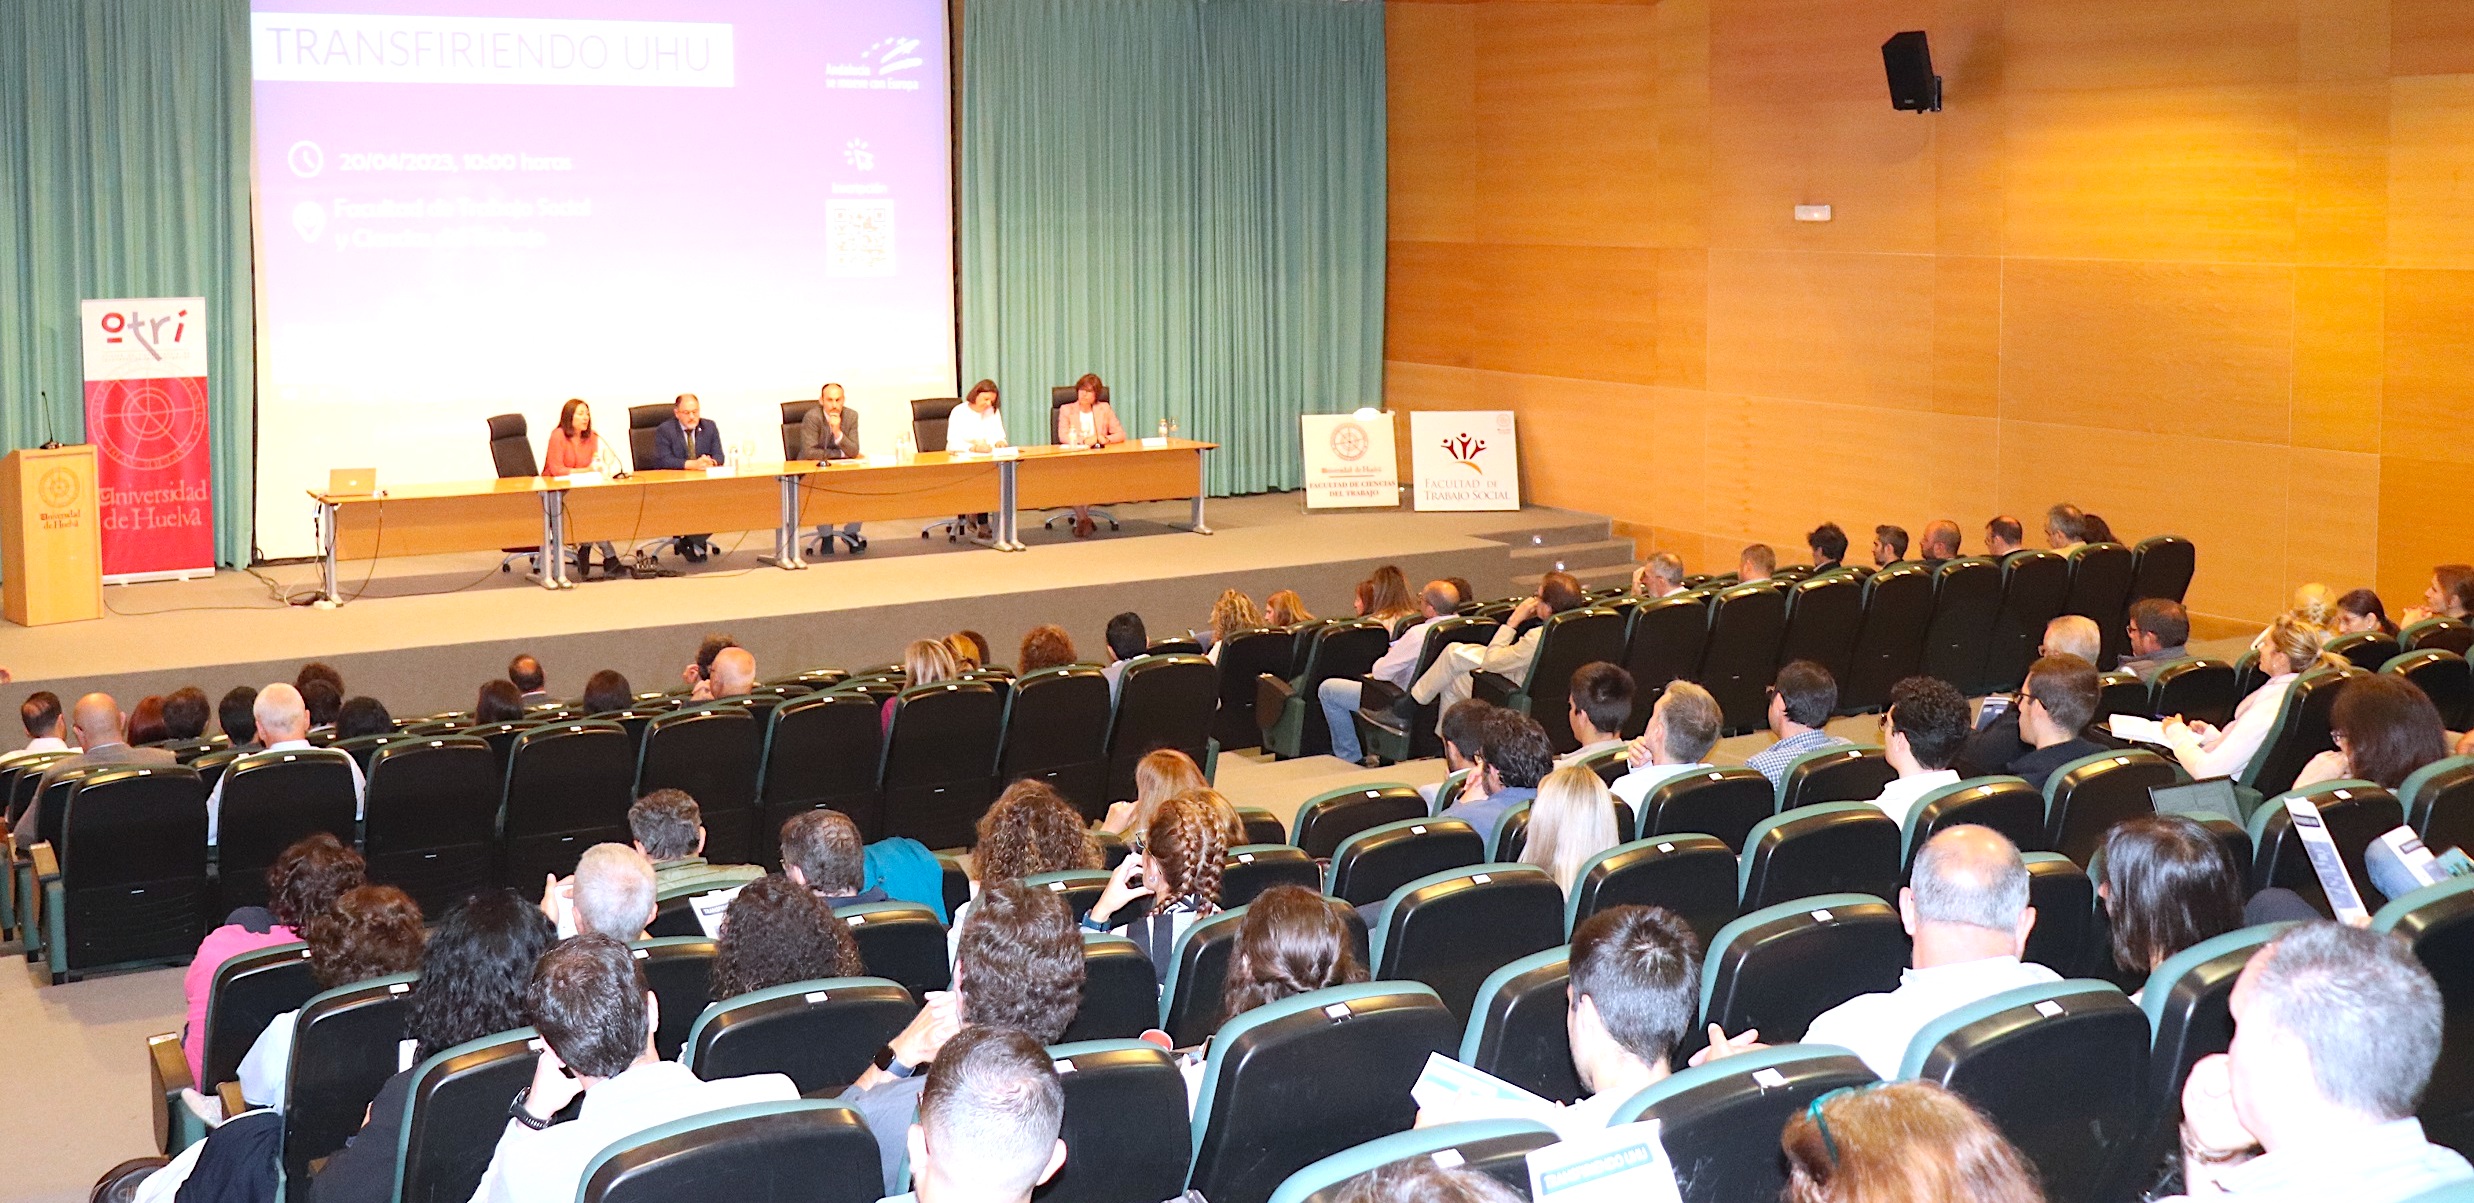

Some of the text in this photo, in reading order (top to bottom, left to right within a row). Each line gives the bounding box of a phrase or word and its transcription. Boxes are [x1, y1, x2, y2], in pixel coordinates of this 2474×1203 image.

[265, 27, 710, 72] TRANSFIRIENDO UHU
[463, 153, 516, 172] 10:00
[521, 151, 573, 172] horas
[1361, 480, 1397, 488] CIENCIAS
[1425, 478, 1498, 489] FACULTAD DE
[98, 479, 208, 506] Universidad
[1346, 489, 1380, 498] TRABAJO
[1424, 490, 1511, 501] TRABAJO SOCIAL
[103, 505, 203, 530] de Huelva
